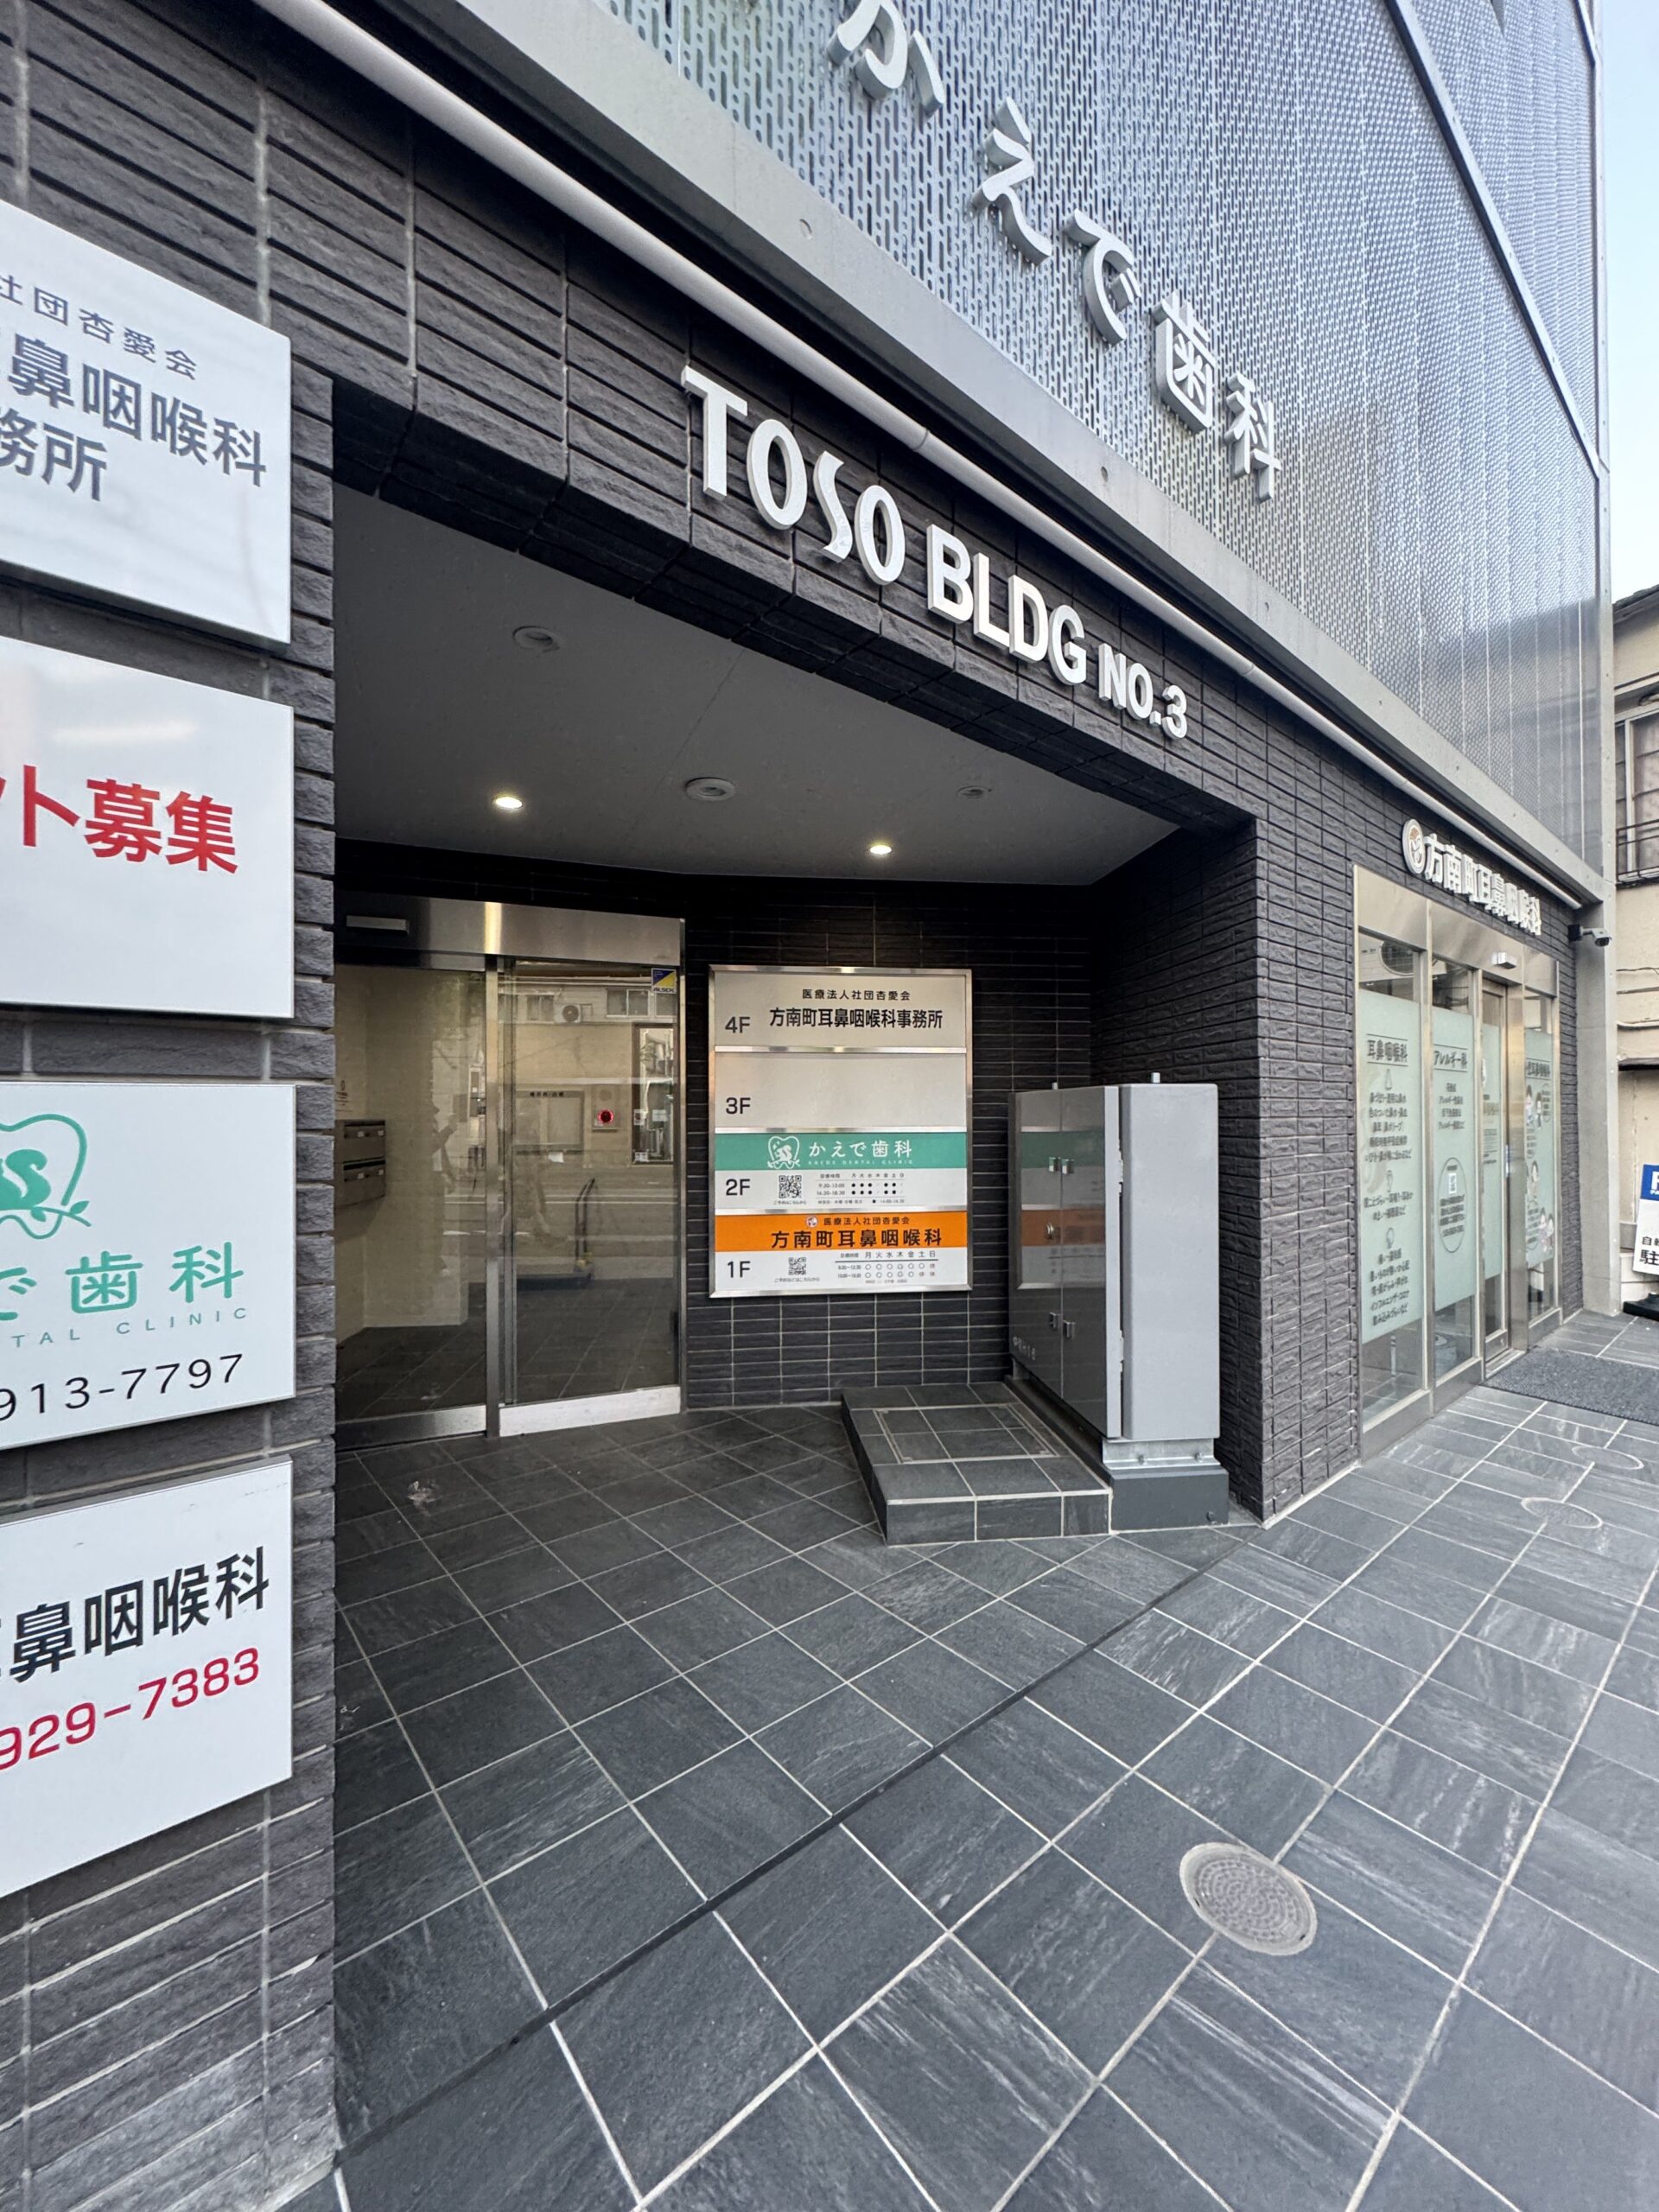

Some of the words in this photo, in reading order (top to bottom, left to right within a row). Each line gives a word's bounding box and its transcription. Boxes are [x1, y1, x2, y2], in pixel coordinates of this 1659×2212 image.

[826, 0, 1281, 503] かえで歯科
[0, 275, 197, 381] 社団杏愛会
[8, 333, 267, 488] 鼻咽喉科
[681, 365, 906, 587] TOSO
[926, 524, 1087, 687] BLDG
[1098, 642, 1189, 741] NO.3
[0, 764, 238, 874] ト募集
[802, 988, 911, 1001] 医療法人社団杏愛会
[725, 1016, 751, 1033] 4F
[769, 1007, 943, 1029] 方南町耳鼻咽喉科事務所
[726, 1097, 751, 1114] 3F
[809, 1140, 912, 1158] かえで歯科
[726, 1179, 751, 1196] 2F
[772, 1229, 942, 1249] 方南町耳鼻咽喉科
[728, 1261, 751, 1278] 1F
[12, 1327, 81, 1348] TAL
[116, 1307, 247, 1335] CLINIC
[0, 1353, 244, 1421] 913-7797
[10, 1546, 270, 1683] 鼻咽喉科
[0, 1647, 259, 1770] 929-7383
